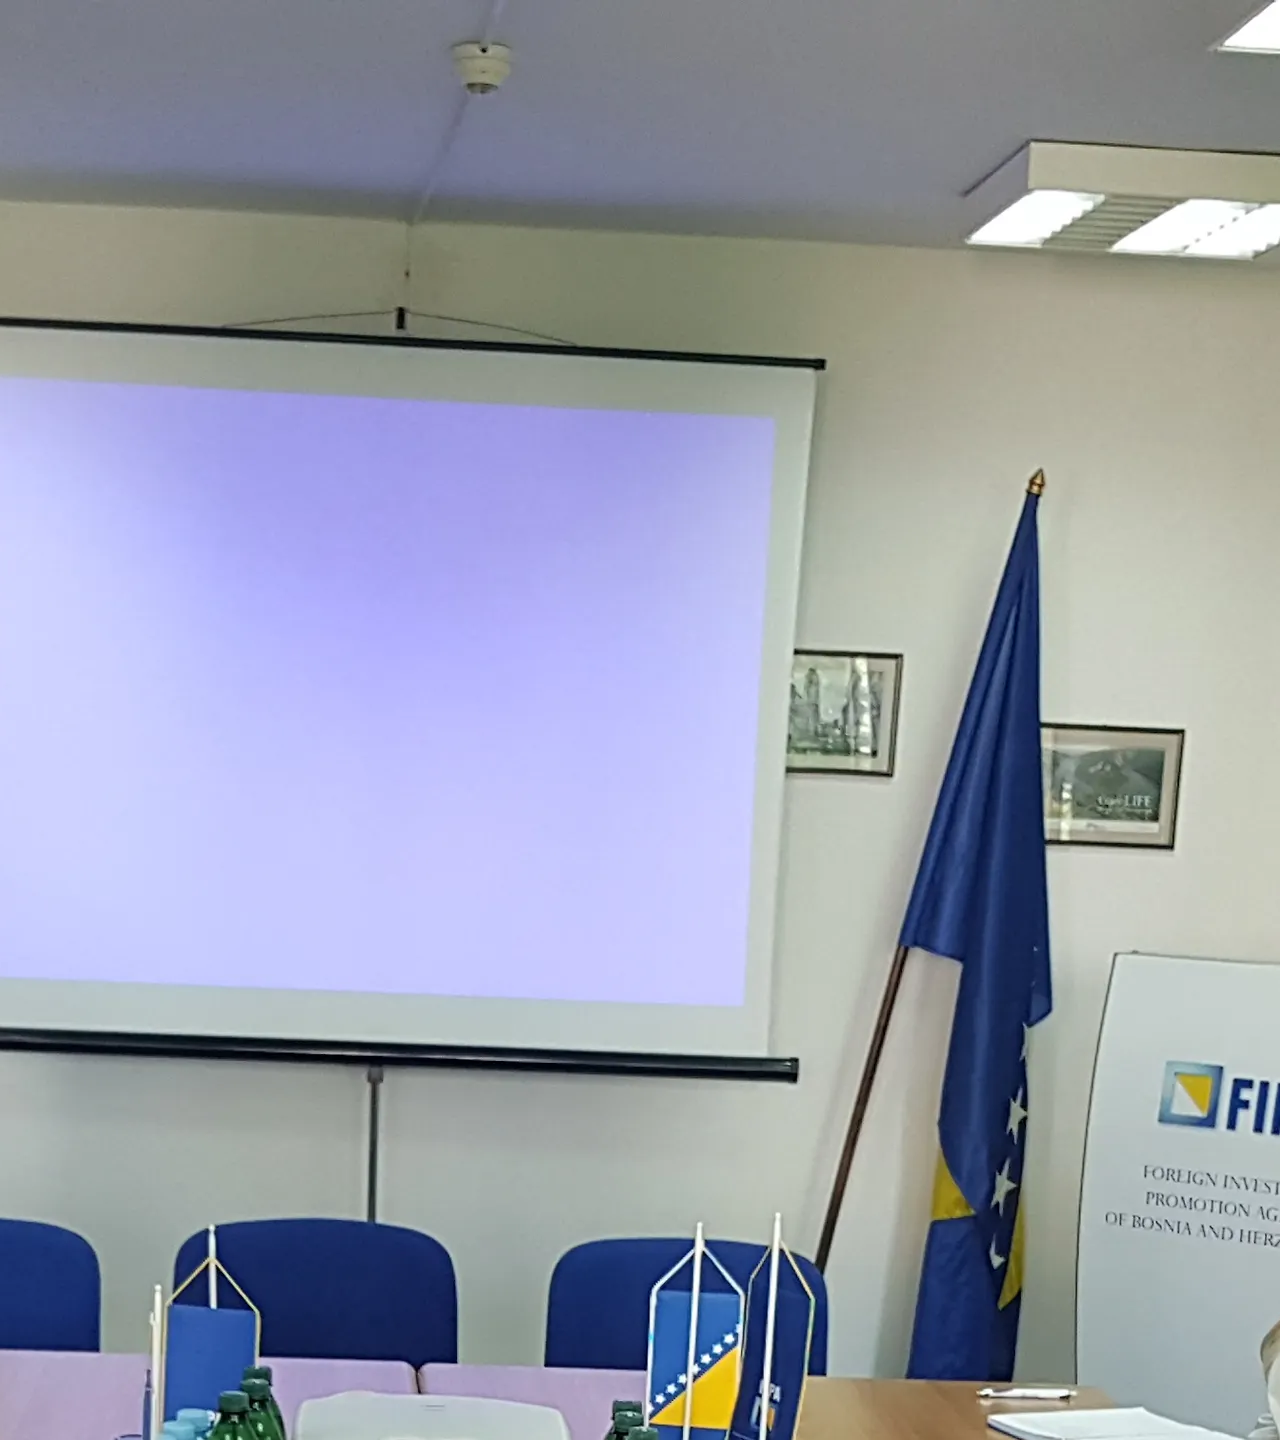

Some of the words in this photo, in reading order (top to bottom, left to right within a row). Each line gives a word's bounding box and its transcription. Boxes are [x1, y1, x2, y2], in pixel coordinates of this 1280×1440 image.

[1143, 1164, 1218, 1188] FOREIGN
[1145, 1190, 1251, 1218] PROMOTION
[1105, 1210, 1127, 1226] OF
[1131, 1214, 1192, 1237] BOSNIA
[1198, 1223, 1234, 1241] AND
